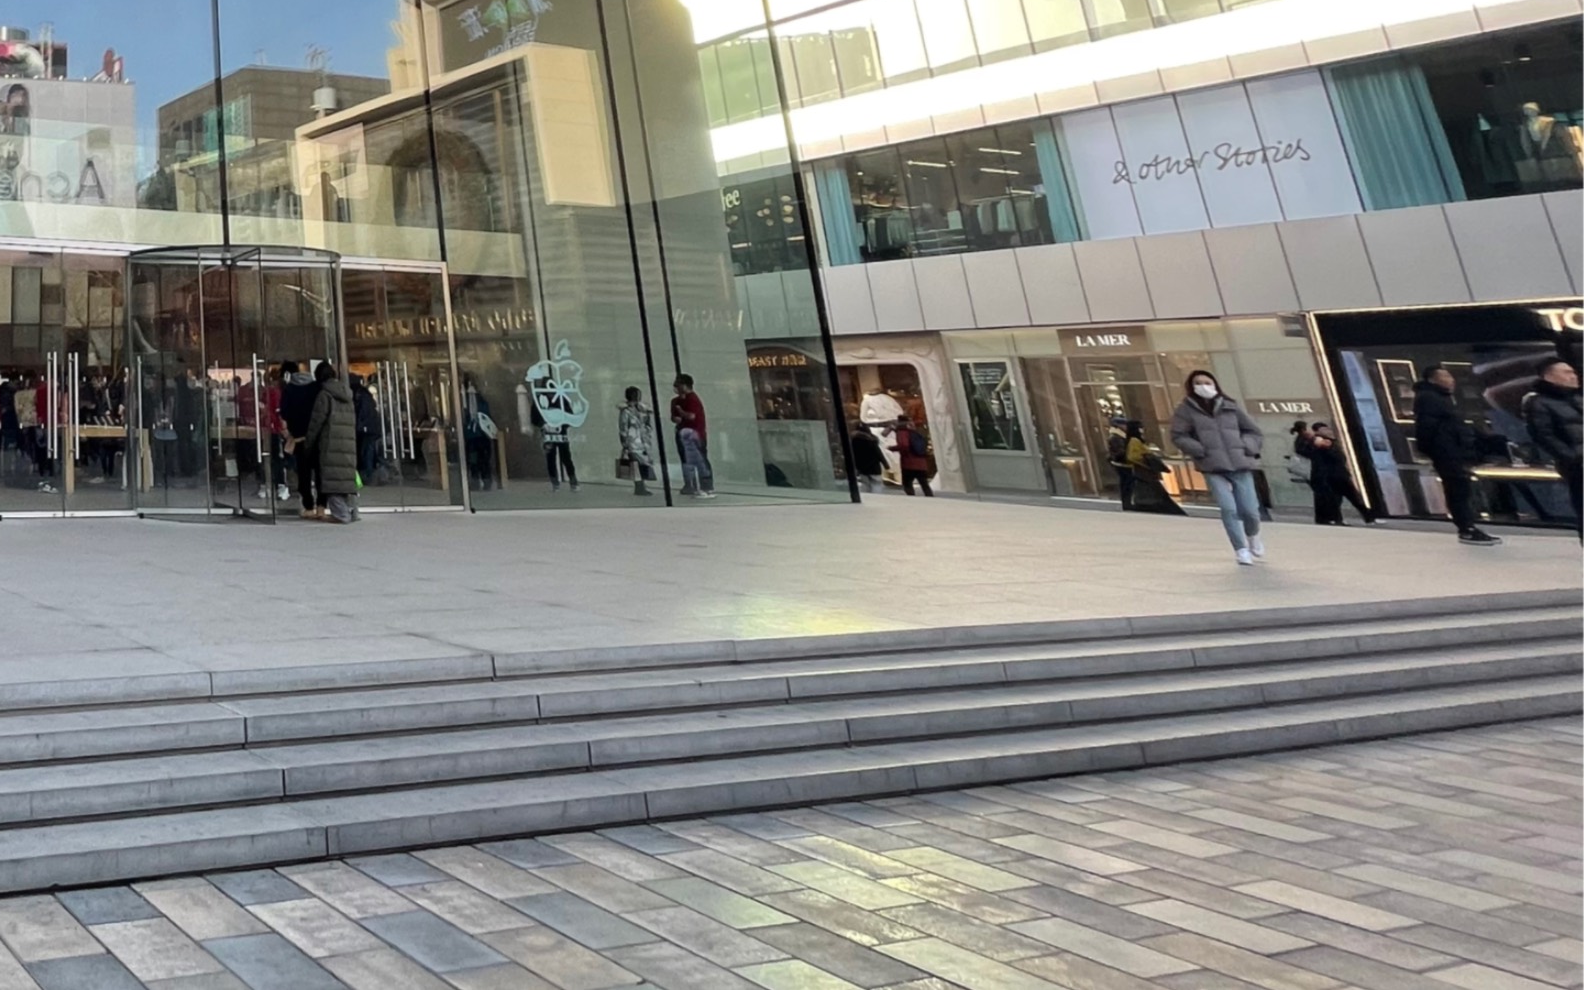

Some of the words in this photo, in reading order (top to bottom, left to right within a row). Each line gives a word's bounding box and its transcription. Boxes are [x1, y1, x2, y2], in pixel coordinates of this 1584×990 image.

[1112, 160, 1137, 184] &
[1138, 151, 1209, 180] other
[1213, 138, 1311, 171] Stories
[1076, 335, 1096, 347] LA
[1096, 334, 1131, 346] MER
[1259, 402, 1280, 413] LA
[1279, 402, 1313, 413] MER
